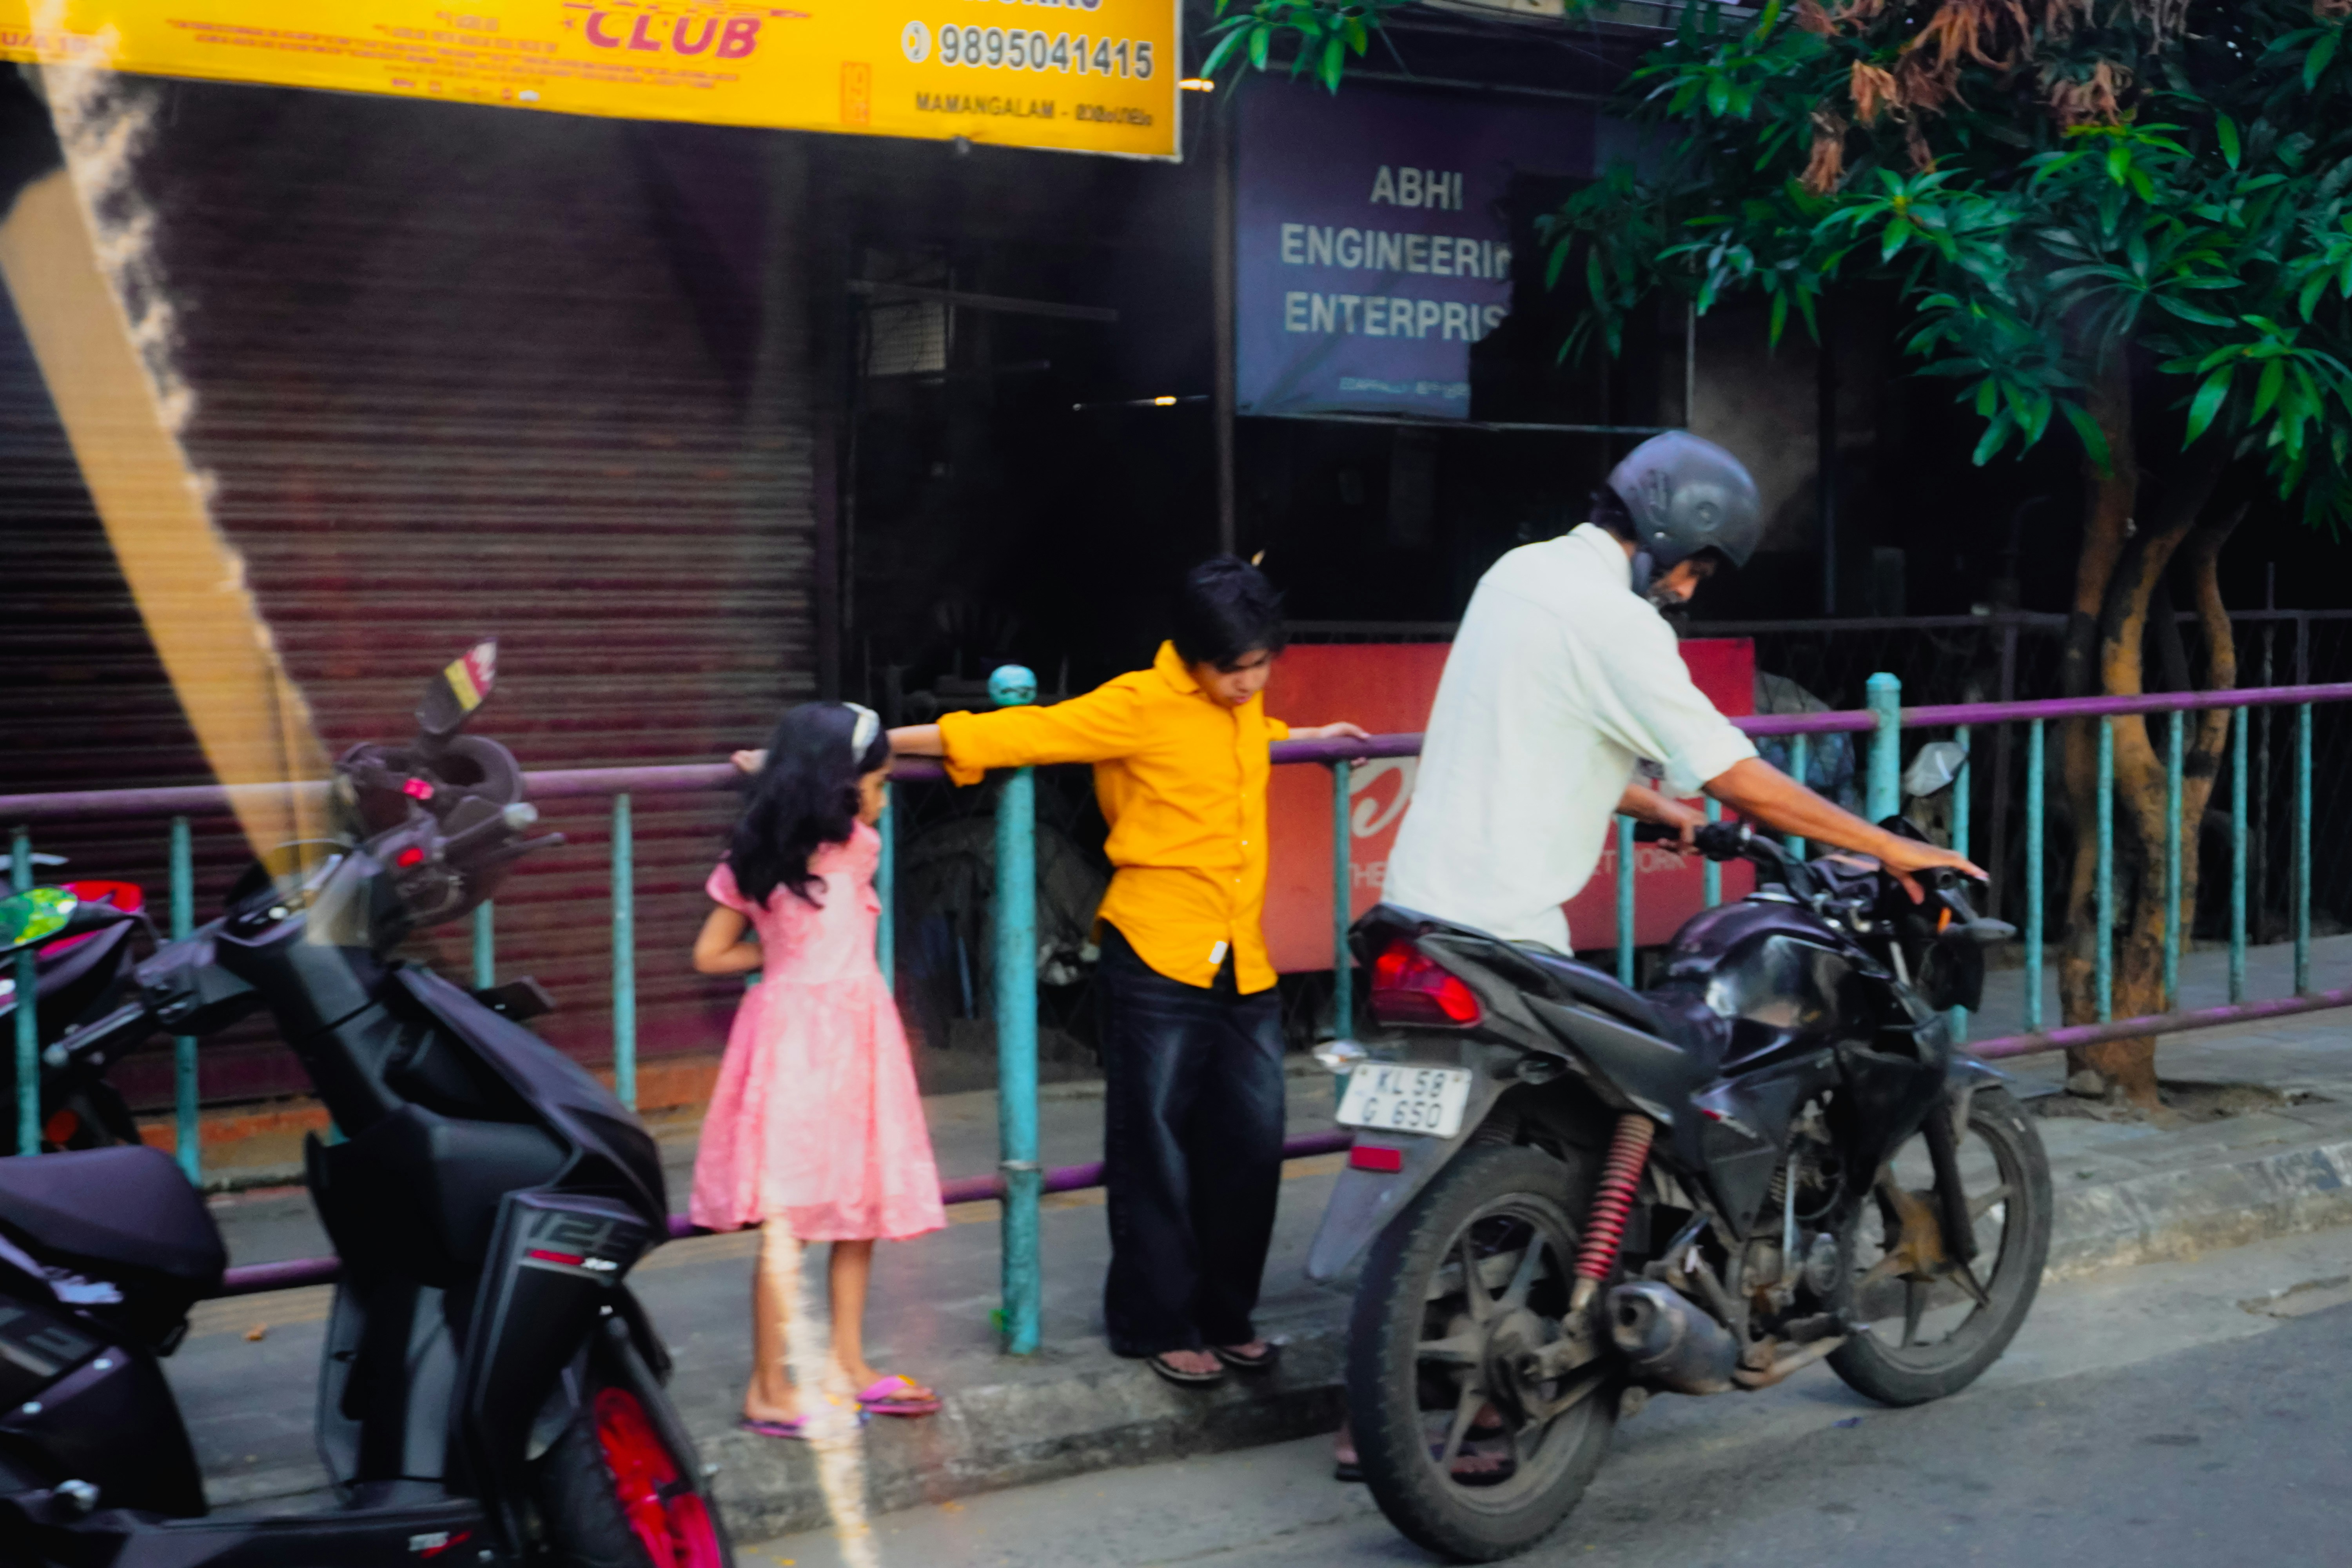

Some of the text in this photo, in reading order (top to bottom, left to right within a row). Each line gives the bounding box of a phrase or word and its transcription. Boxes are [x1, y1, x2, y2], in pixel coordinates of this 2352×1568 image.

[585, 11, 762, 59] CLUB
[940, 25, 1153, 79] 9895041415
[916, 91, 1054, 119] MAMANGALAM
[1371, 165, 1463, 210] ABHI
